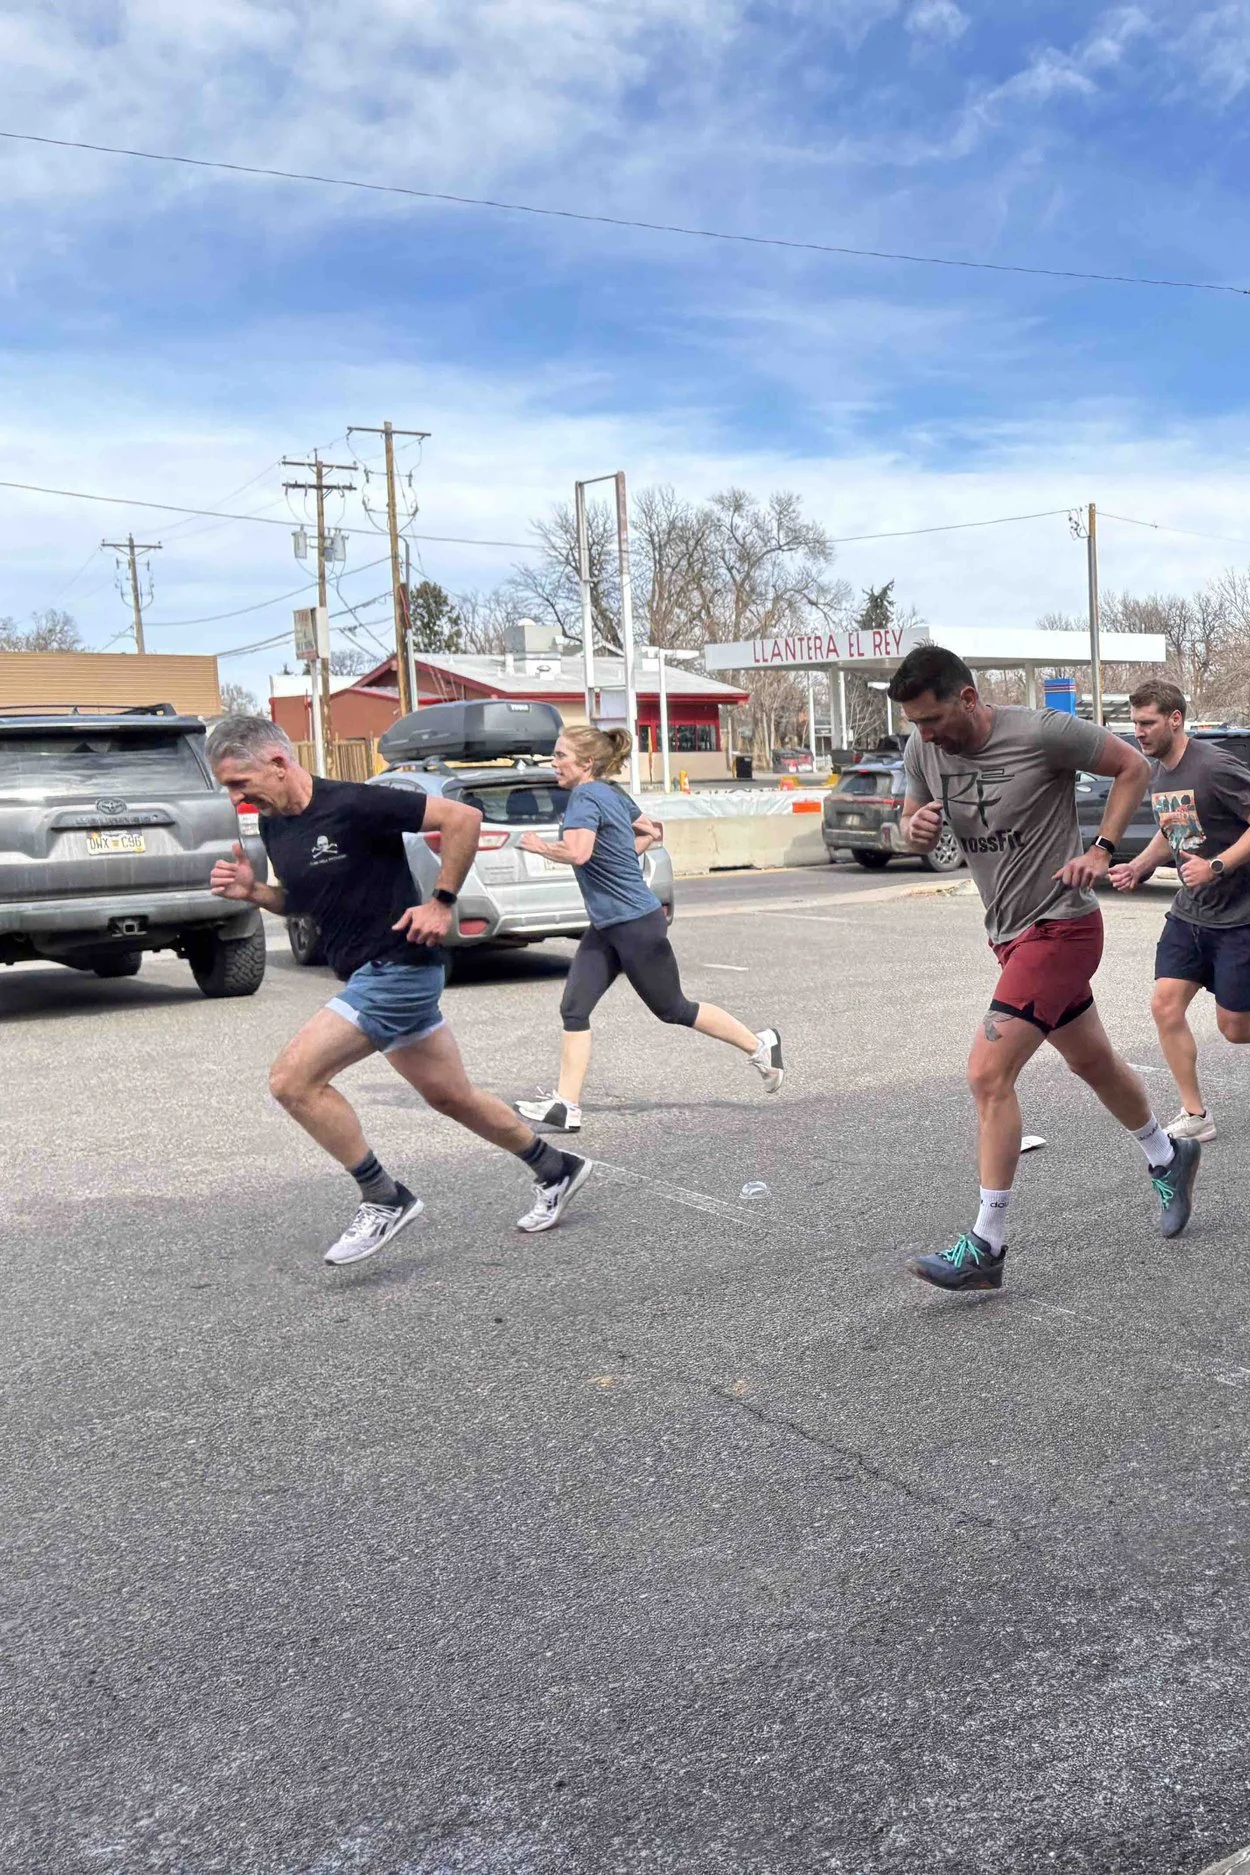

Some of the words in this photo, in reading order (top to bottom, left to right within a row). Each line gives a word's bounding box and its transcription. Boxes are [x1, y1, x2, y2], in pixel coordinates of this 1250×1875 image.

[753, 634, 839, 663] LLANTERA
[848, 632, 865, 657] EL
[872, 629, 903, 656] REY
